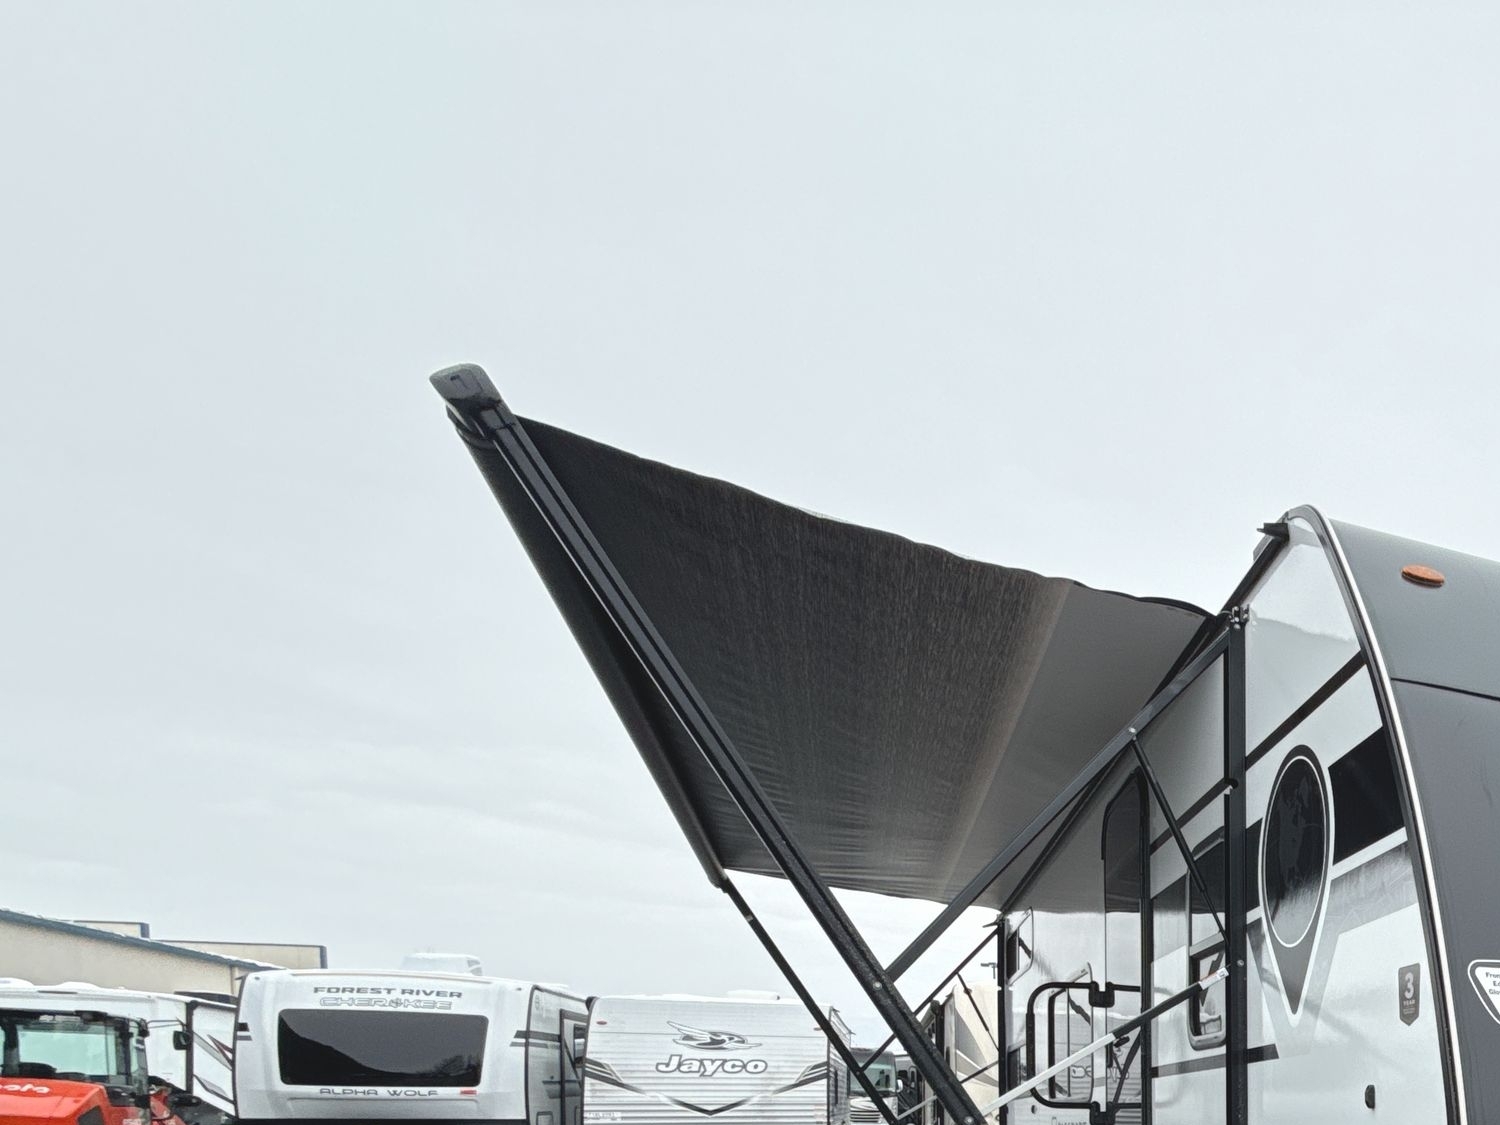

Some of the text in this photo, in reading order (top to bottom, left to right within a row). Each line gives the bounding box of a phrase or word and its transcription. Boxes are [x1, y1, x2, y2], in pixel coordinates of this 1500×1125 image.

[313, 986, 463, 999] FOREST RIVER
[1404, 972, 1415, 1000] 3
[655, 1054, 768, 1077] Jayco
[0, 1083, 50, 1094] ota
[319, 1088, 439, 1097] ALPHA WOLF
